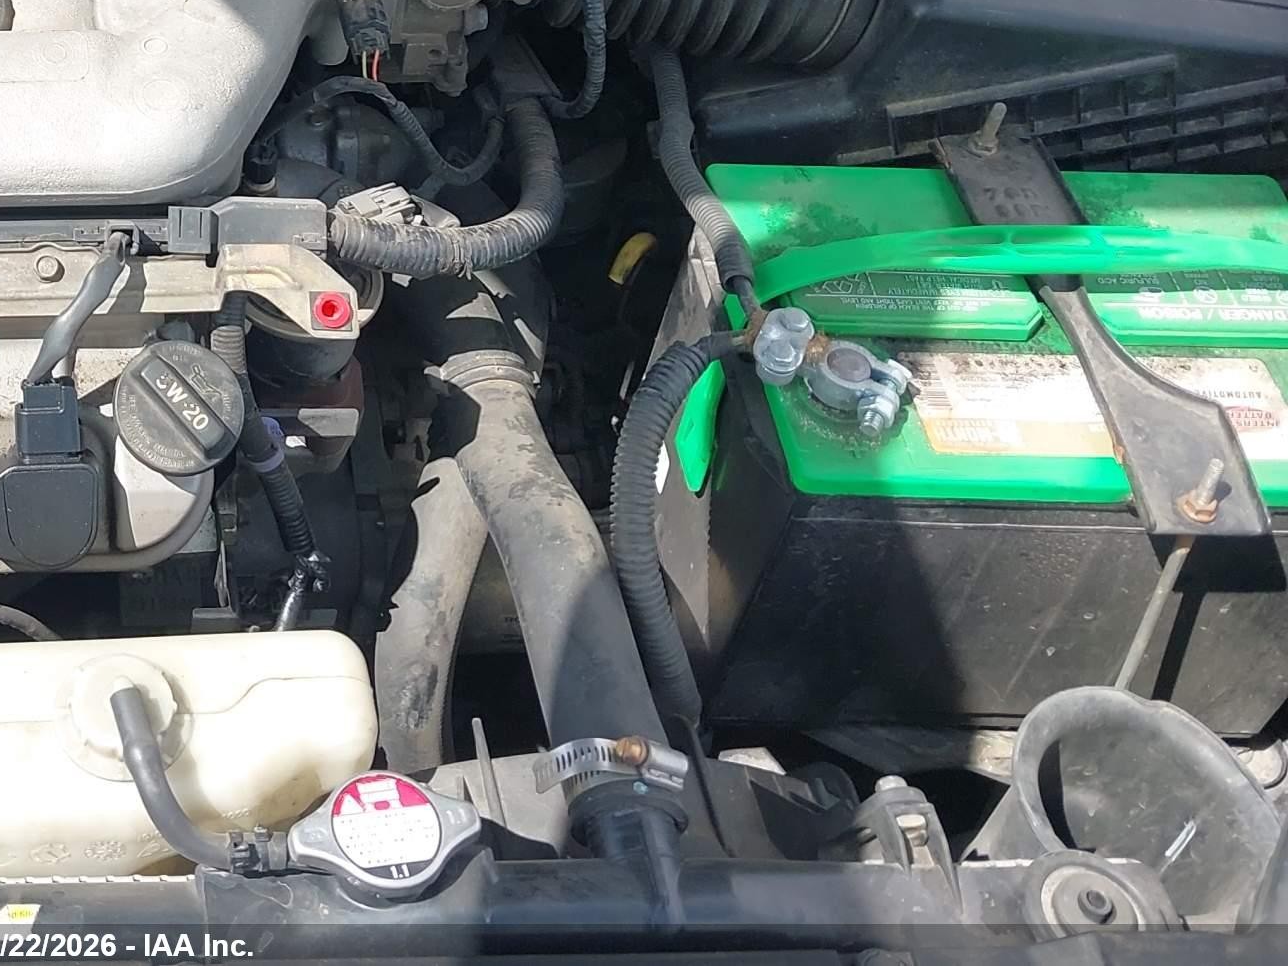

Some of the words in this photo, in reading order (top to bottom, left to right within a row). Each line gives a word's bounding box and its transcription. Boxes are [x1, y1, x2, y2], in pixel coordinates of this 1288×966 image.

[888, 287, 937, 295] IMMEDIATELY
[1137, 307, 1204, 320] POISON
[389, 864, 411, 879] 1.1
